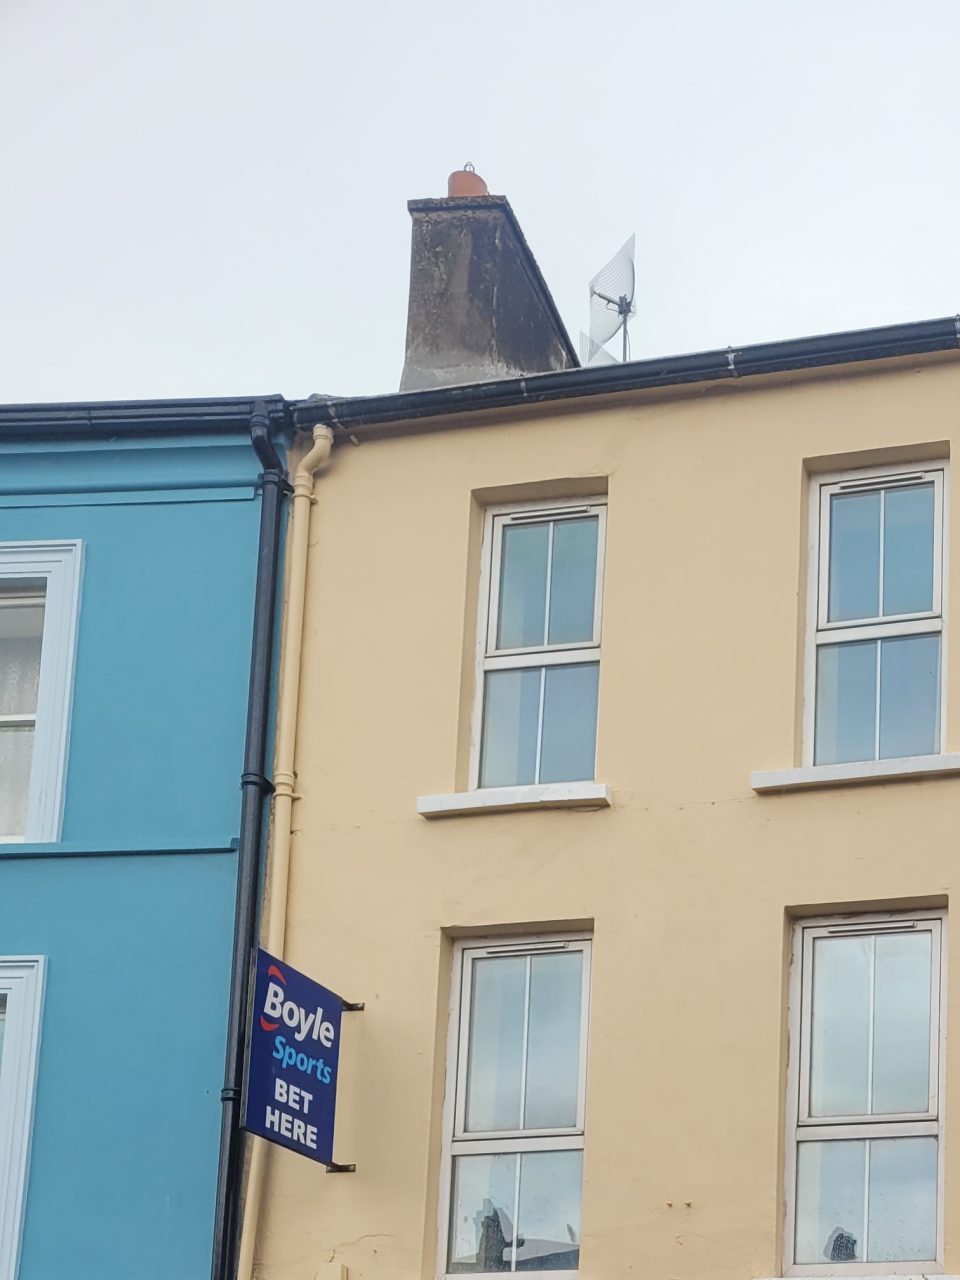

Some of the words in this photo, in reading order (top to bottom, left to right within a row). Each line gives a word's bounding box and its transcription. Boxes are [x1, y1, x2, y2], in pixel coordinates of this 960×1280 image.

[263, 982, 335, 1048] Boyle
[272, 1035, 332, 1084] Sports
[274, 1077, 313, 1115] BET
[265, 1105, 318, 1150] HERE
